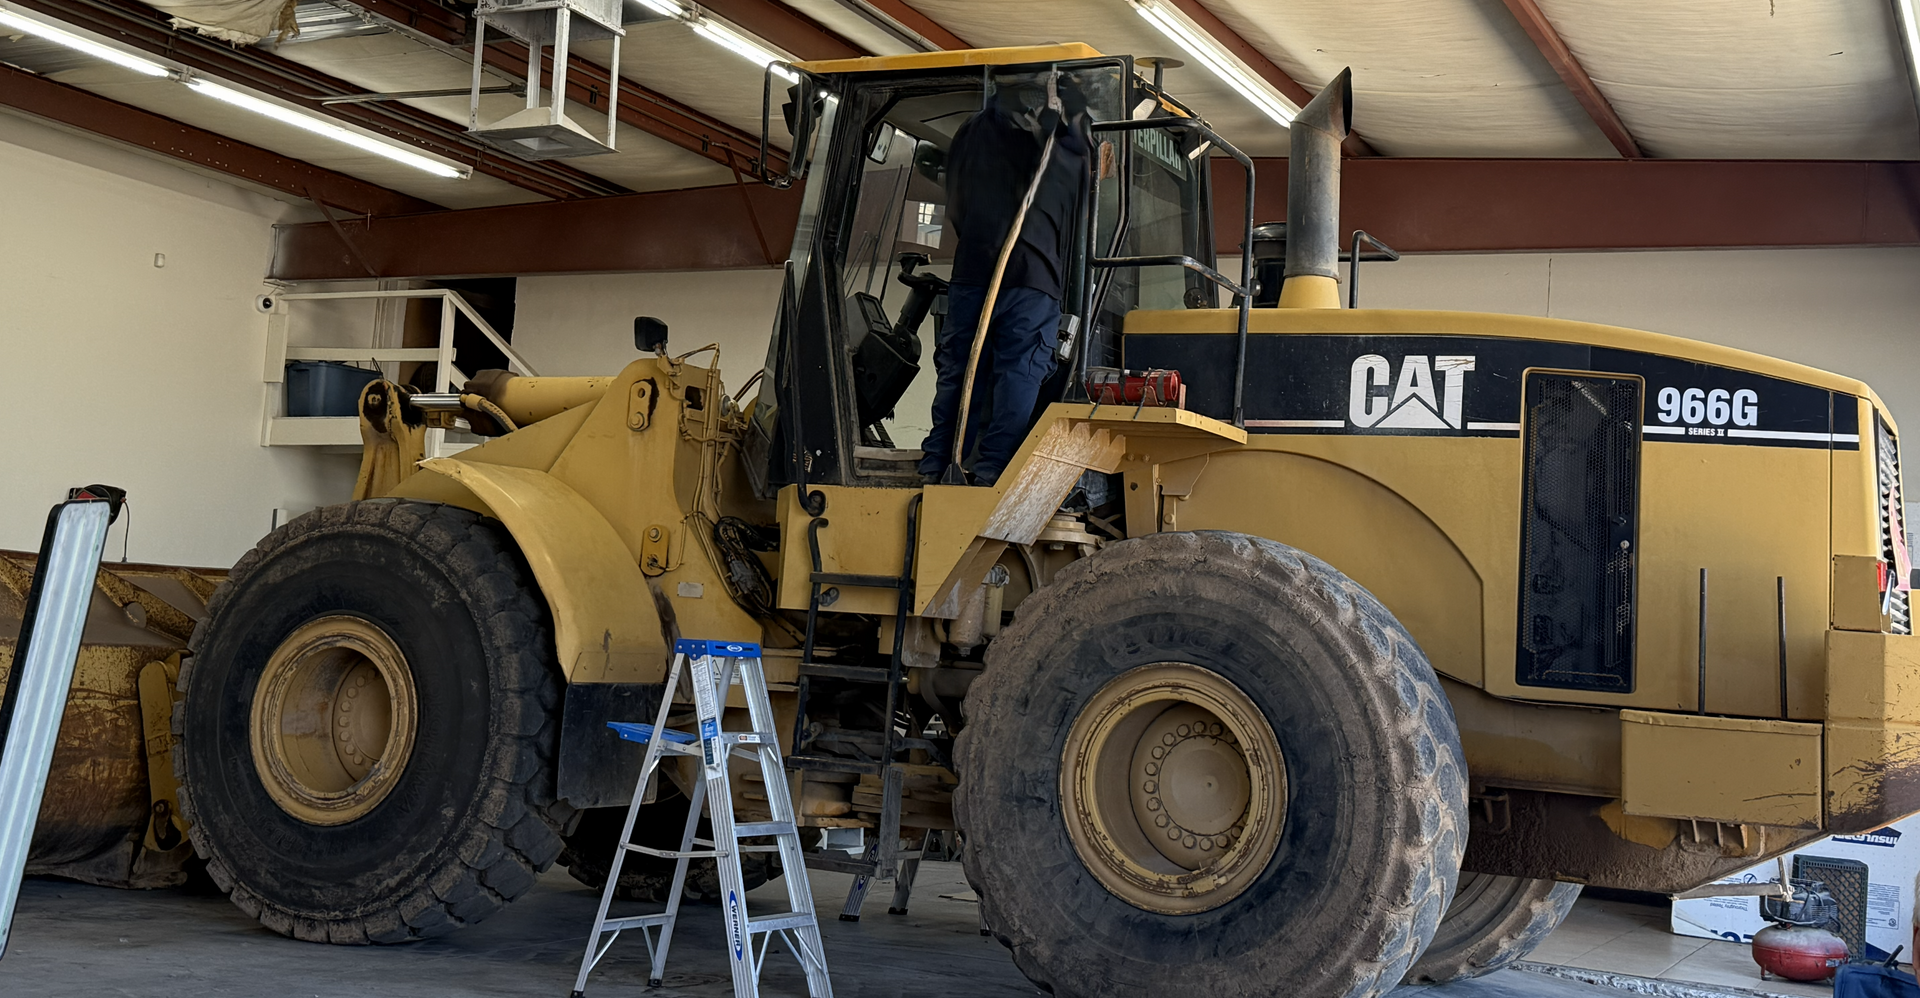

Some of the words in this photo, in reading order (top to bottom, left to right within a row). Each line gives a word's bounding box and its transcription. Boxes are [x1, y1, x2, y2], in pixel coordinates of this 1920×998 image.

[1133, 128, 1181, 171] TERPILLAR
[1348, 354, 1476, 430] CAT
[1657, 387, 1758, 426] 966G
[1688, 427, 1715, 436] SERIES
[731, 905, 741, 947] WERNER
